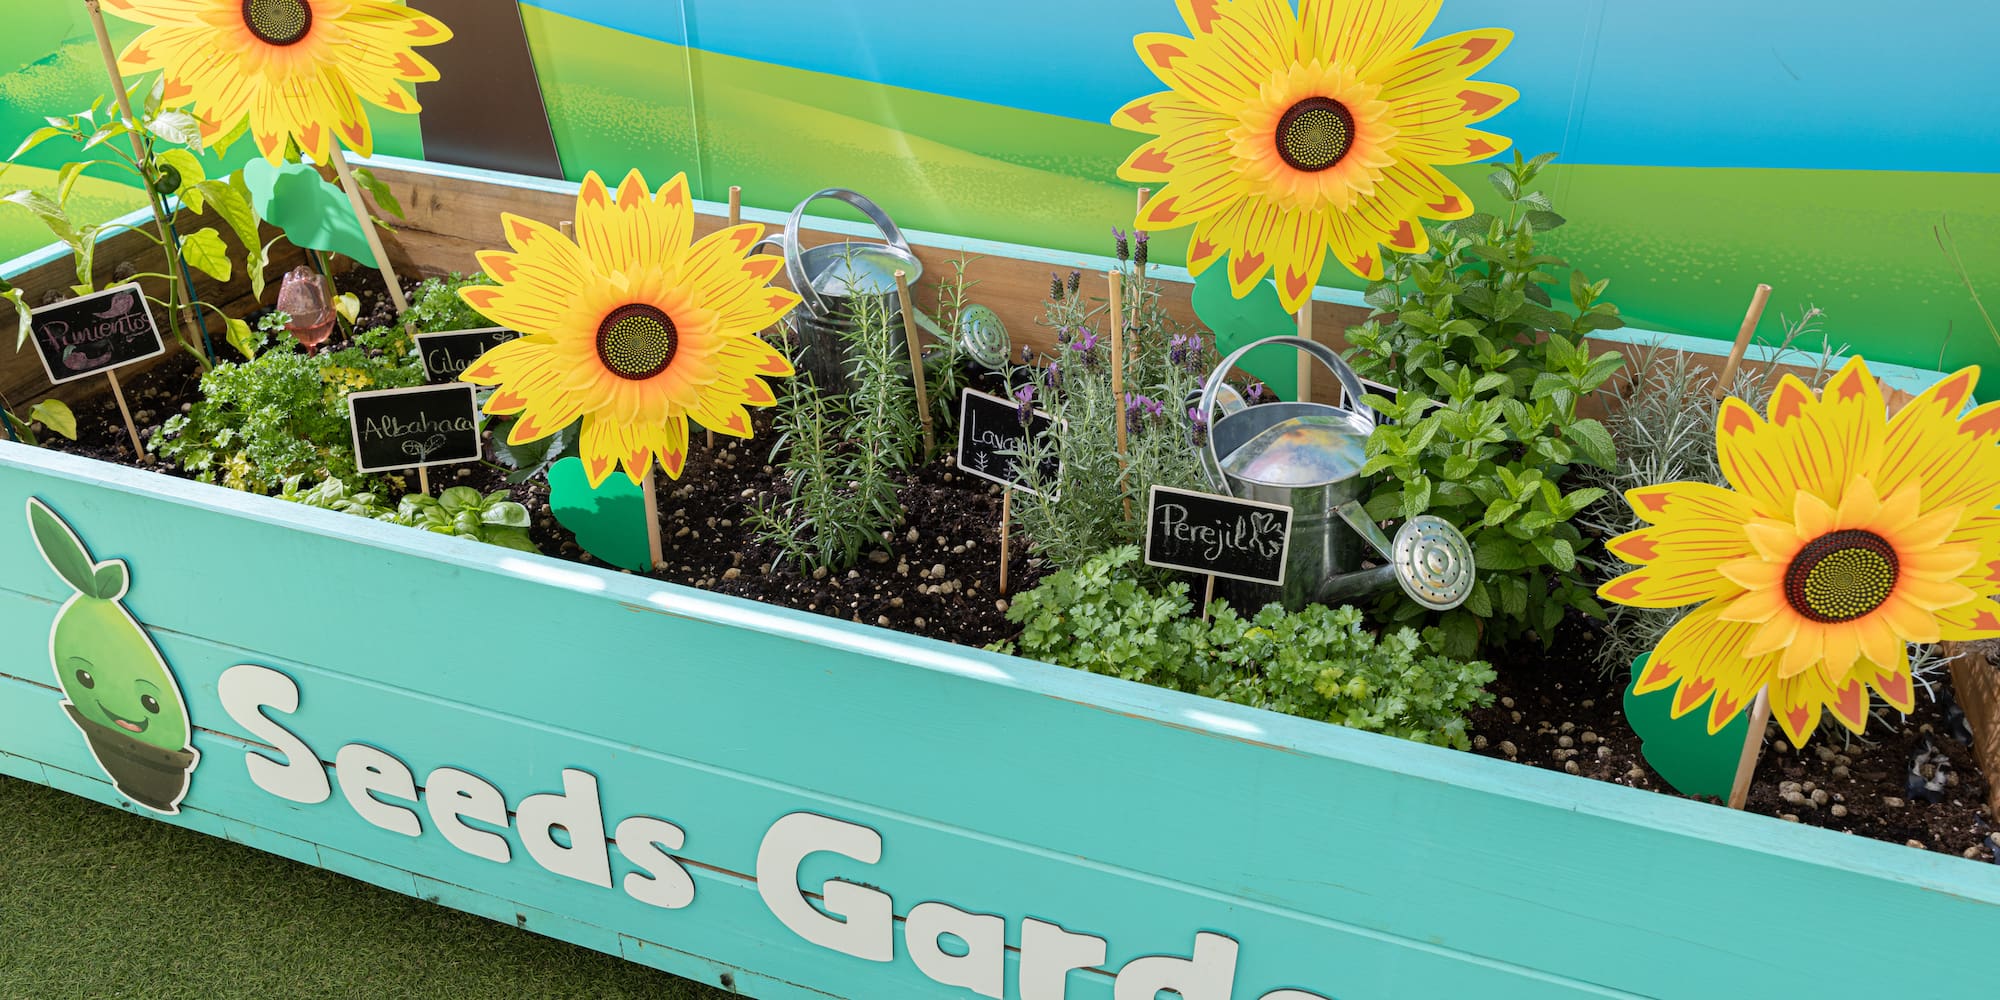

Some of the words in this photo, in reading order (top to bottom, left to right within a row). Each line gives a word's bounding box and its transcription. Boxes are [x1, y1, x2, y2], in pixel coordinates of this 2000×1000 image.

[361, 411, 475, 440] Albahaca
[972, 409, 1058, 467] Lavan
[1155, 503, 1248, 561] Perejil
[218, 664, 695, 908] Seeds
[756, 811, 1331, 1000] Gard
